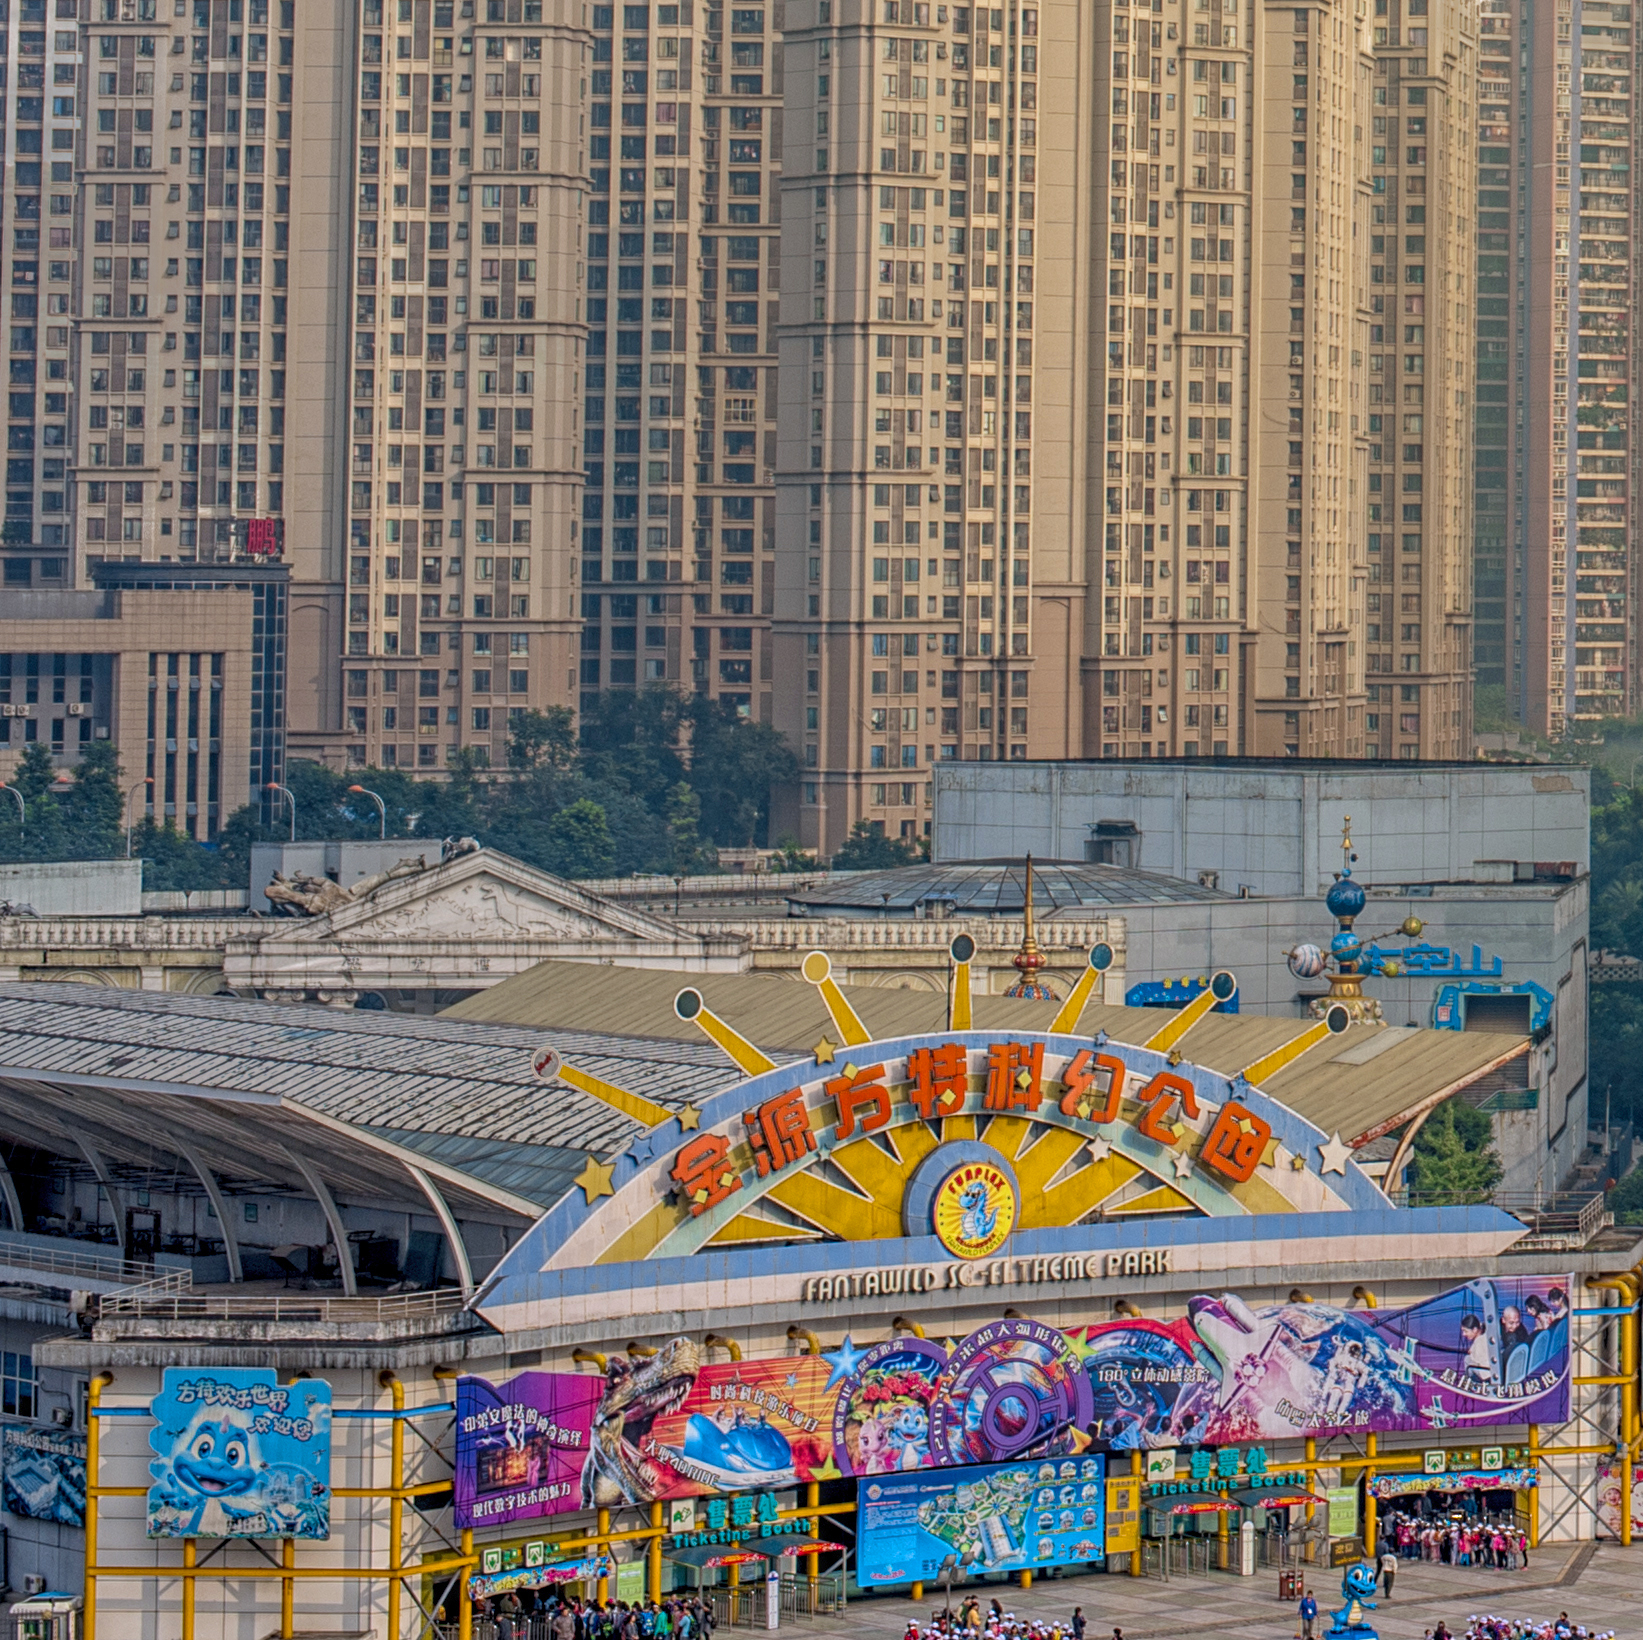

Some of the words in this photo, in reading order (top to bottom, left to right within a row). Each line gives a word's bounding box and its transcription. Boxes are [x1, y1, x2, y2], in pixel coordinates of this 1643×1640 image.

[668, 1041, 1273, 1218] 金源方特科幻公园
[948, 1166, 1006, 1195] FUNPLEX
[806, 1268, 936, 1301] FANTAWILD
[1019, 1254, 1097, 1283] THEME
[1107, 1249, 1173, 1277] PARK
[177, 1377, 290, 1413] 方特欢乐世界
[709, 1383, 820, 1433] 时尚科技游乐项目
[1274, 1397, 1372, 1429] 体验太空之旅
[248, 1416, 314, 1442] 欢迎您
[463, 1403, 583, 1447] 印第安魔法的神奇演绎
[1190, 1445, 1268, 1479] 售票处
[472, 1482, 572, 1519] 现代数字技术的魅力
[1150, 1477, 1239, 1497] Ticketing
[1251, 1474, 1307, 1488] Booth
[707, 1491, 779, 1529] 售票处
[672, 1528, 751, 1549] Ticketing
[760, 1518, 812, 1538] Booth
